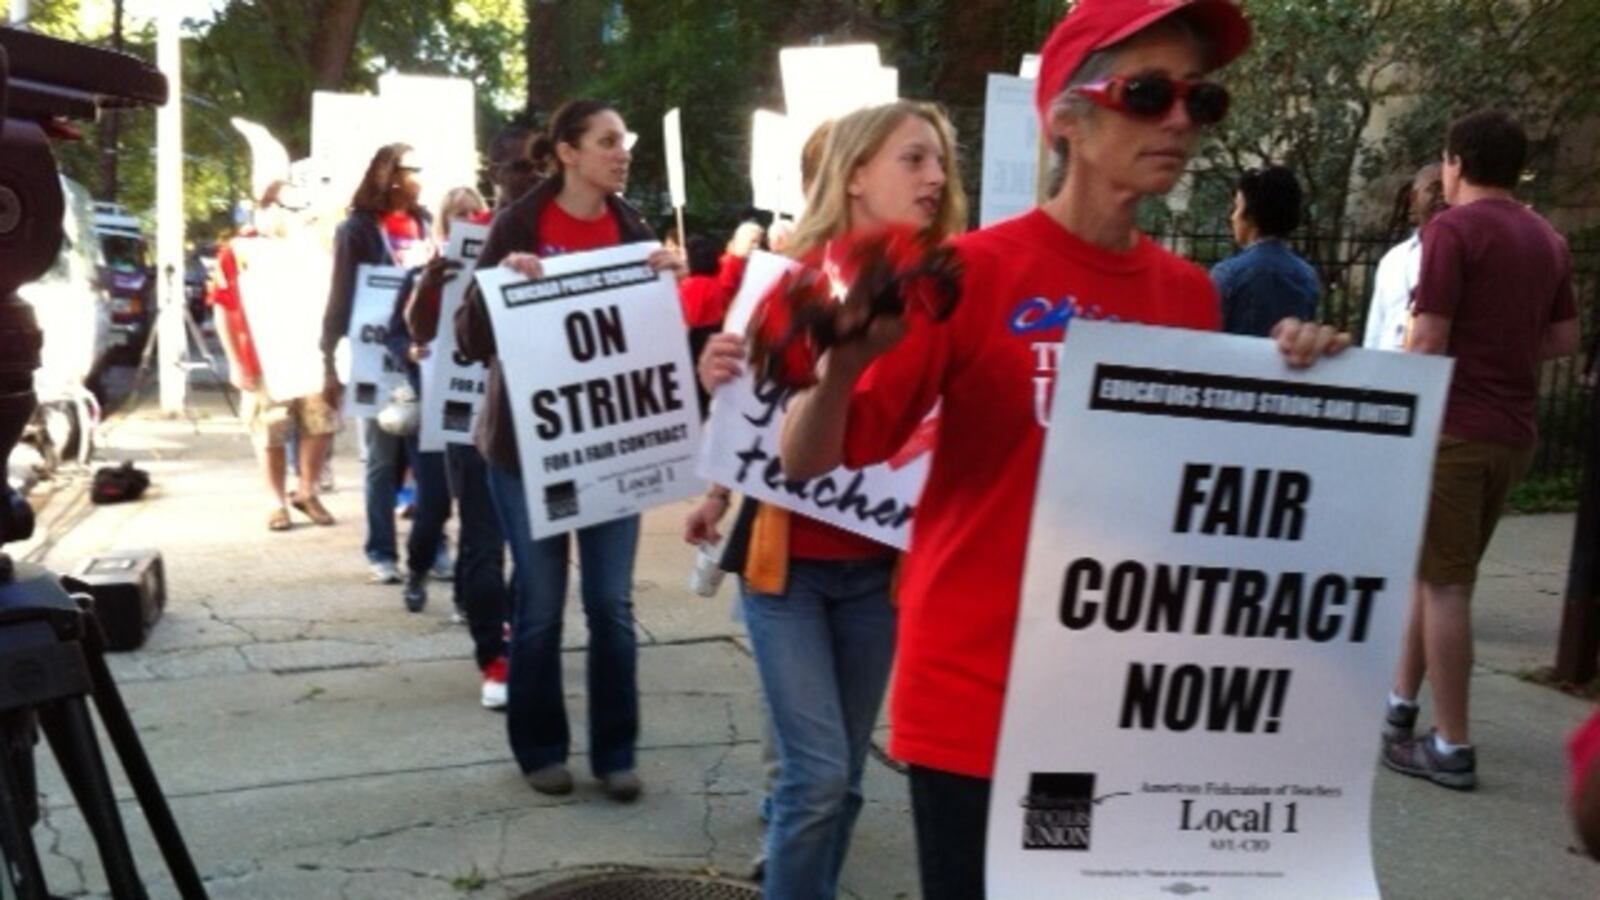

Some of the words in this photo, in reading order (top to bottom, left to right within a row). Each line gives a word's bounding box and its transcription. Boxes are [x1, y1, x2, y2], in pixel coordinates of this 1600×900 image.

[564, 305, 628, 362] ON
[533, 363, 682, 440] STRIKE
[1100, 379, 1200, 407] EDUCATORS
[1202, 387, 1256, 411] STAND
[1256, 393, 1324, 418] STRONG
[1323, 400, 1354, 421] AND
[543, 452, 570, 473] FOR
[574, 449, 583, 465] A
[585, 441, 615, 462] FAIR
[618, 424, 688, 455] CONTRACT
[1173, 463, 1312, 541] FAIR
[1059, 557, 1386, 643] CONTRACT
[1119, 662, 1292, 734] NOW!
[1141, 782, 1201, 794] American
[1275, 784, 1289, 796] of
[1178, 799, 1273, 833] Local
[1283, 801, 1299, 834] 1
